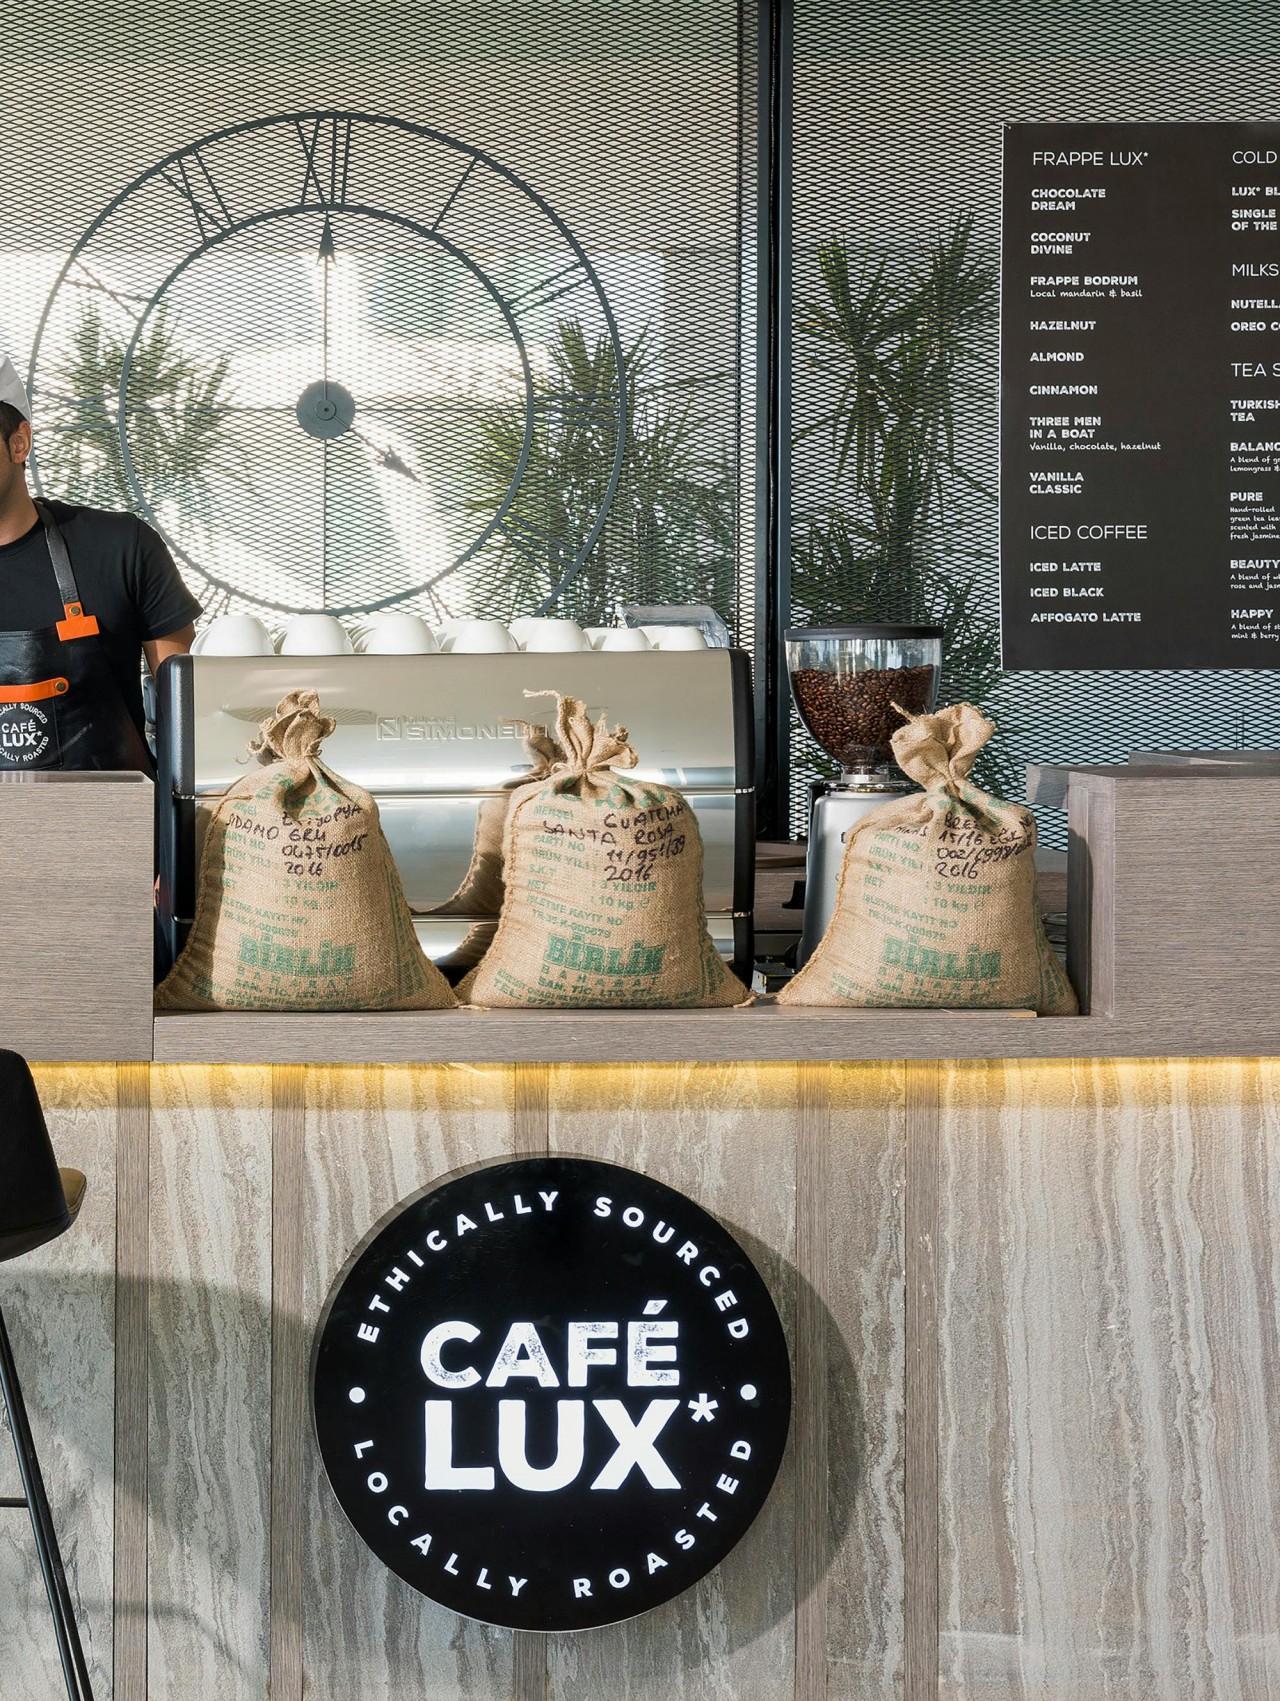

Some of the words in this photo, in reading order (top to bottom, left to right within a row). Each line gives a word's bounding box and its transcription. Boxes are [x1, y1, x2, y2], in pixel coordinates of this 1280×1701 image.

[1033, 151, 1104, 166] FRAPPE
[1232, 150, 1278, 165] COLD
[1031, 188, 1106, 199] CHOCOLATE
[1031, 200, 1076, 211] DREAM
[1231, 208, 1277, 219] SINGLE
[1231, 221, 1249, 231] OF
[1252, 221, 1278, 231] THE
[1030, 232, 1091, 243] COCONUT
[1030, 244, 1073, 255] DIVINE
[1232, 263, 1280, 277] MILKS
[1030, 275, 1080, 286] FRAPPE
[1083, 275, 1138, 286] BODRUM
[1030, 289, 1057, 298] Local
[1059, 288, 1106, 298] mandarin
[1120, 288, 1143, 298] basil
[1230, 299, 1280, 309] NUTELL
[1030, 320, 1097, 331] HAZELNUT
[1230, 321, 1267, 332] OREO
[1029, 351, 1085, 362] ALMOND
[1230, 362, 1267, 378] TEA
[1029, 384, 1098, 396] CINNAMON
[1029, 416, 1070, 427] THREE
[1074, 416, 1102, 427] MEN
[1229, 412, 1256, 422] TEA
[1029, 428, 1043, 439] IN
[1046, 428, 1057, 439] A
[1061, 428, 1096, 439] BOAT
[1029, 441, 1066, 452] Vanilla,
[1068, 442, 1118, 452] chocolate,
[1120, 441, 1162, 450] hazelnut
[1029, 471, 1085, 482] VANILLA
[1029, 484, 1082, 495] CLASSIC
[1230, 491, 1264, 502] PURE
[1030, 525, 1072, 540] ICED
[1076, 524, 1148, 540] COFFEE
[1029, 562, 1059, 572] ICED
[1062, 561, 1102, 572] LATTE
[1230, 559, 1280, 569] BEAUTY
[1030, 587, 1059, 598] ICED
[1062, 587, 1105, 598] BLACK
[1030, 612, 1099, 623] AFFOGATO
[1102, 612, 1142, 622] LATTE
[1230, 608, 1274, 619] HAPPY
[20, 702, 48, 724] SOURCED
[1, 718, 37, 734] CAFÉ
[22, 736, 49, 762] ROASTED
[356, 1191, 559, 1343] ETHICALLY
[593, 1196, 750, 1340] SOURCED
[420, 1299, 681, 1389] CAFÉ
[353, 1439, 528, 1597] LOCALLY
[572, 1439, 752, 1598] ROASTED
